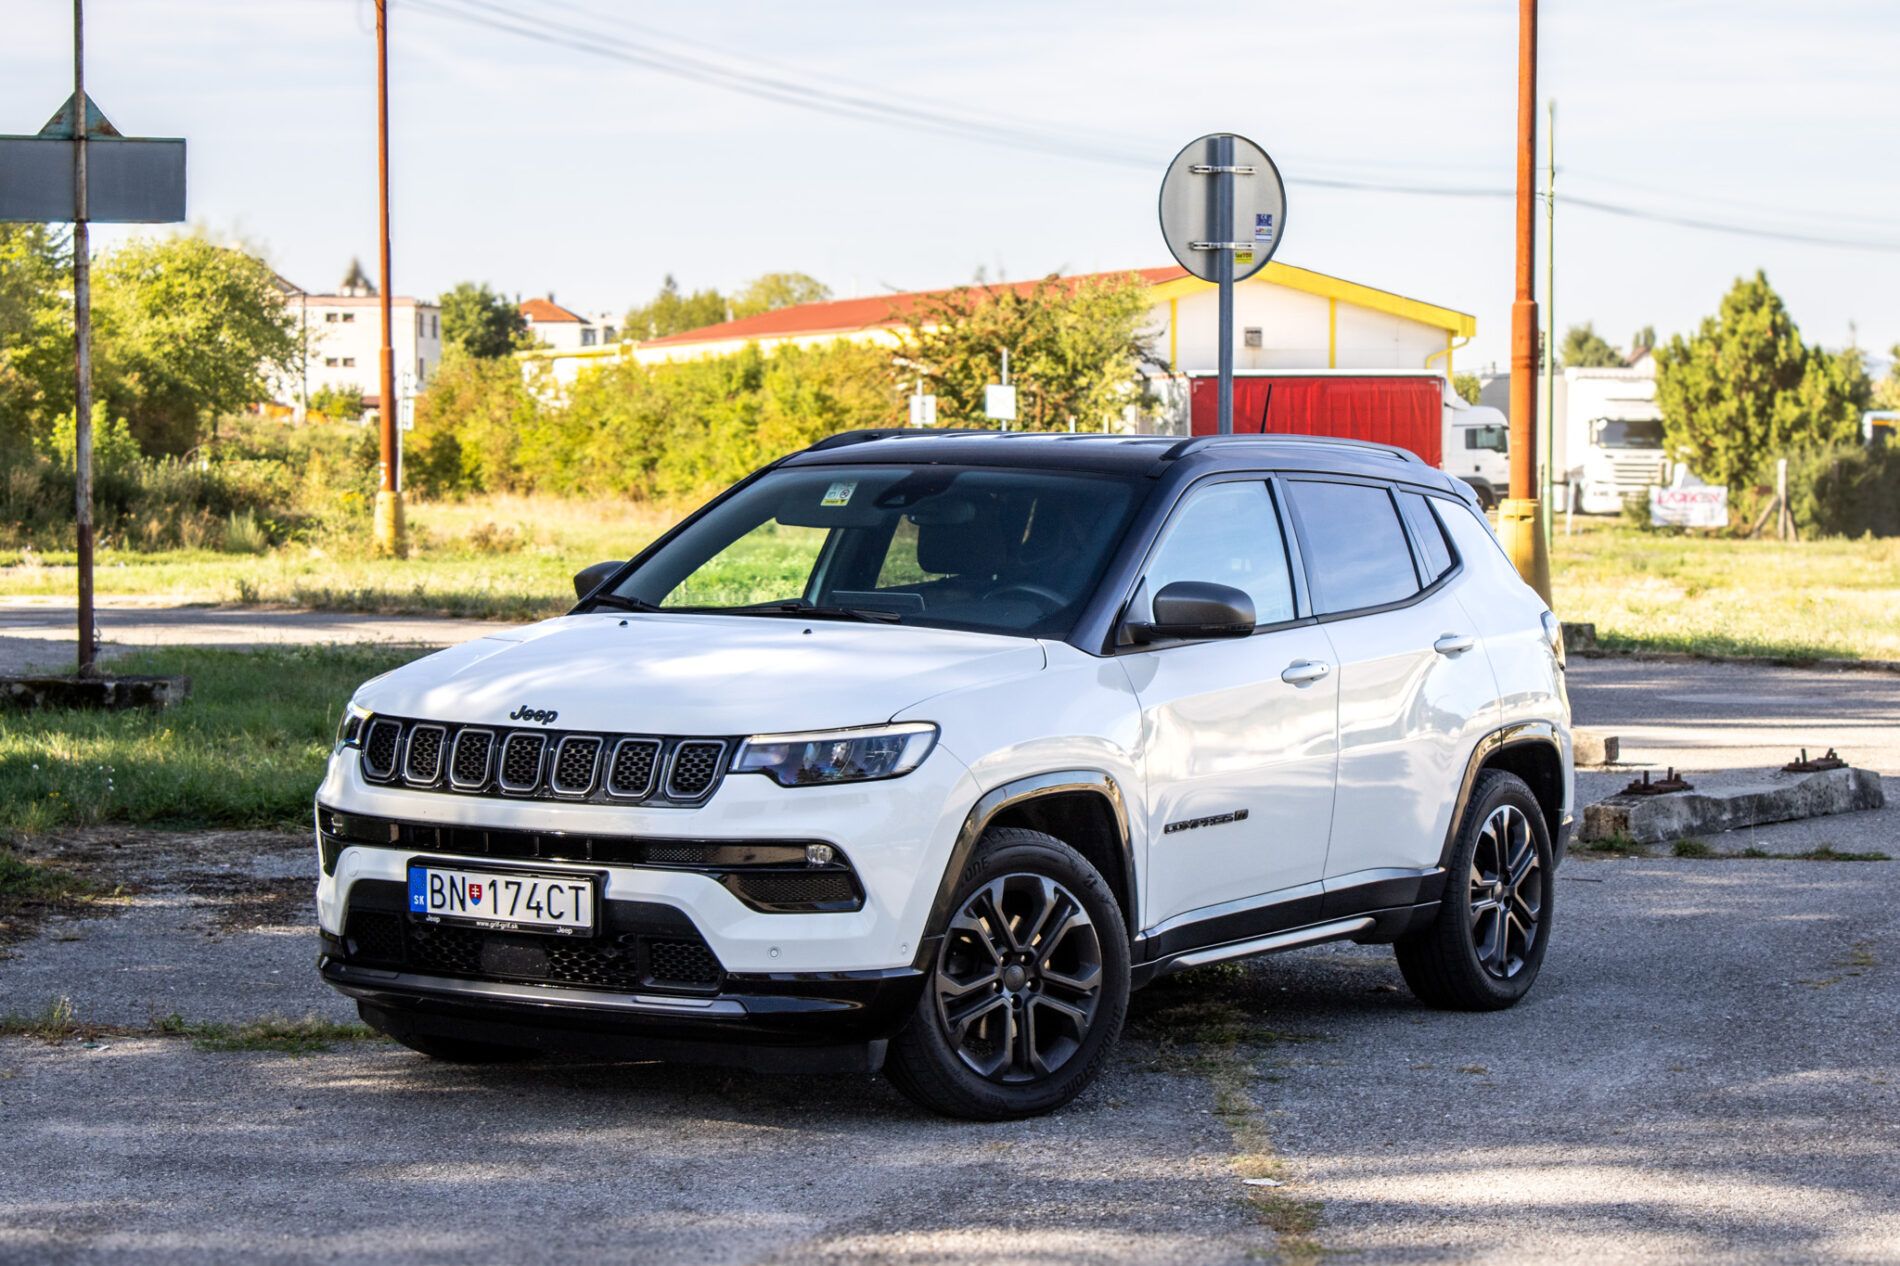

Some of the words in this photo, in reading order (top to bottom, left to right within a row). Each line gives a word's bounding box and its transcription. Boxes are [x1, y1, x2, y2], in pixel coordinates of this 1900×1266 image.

[510, 705, 558, 725] Jeep
[413, 895, 425, 905] SK
[430, 873, 466, 912] BN
[488, 879, 586, 922] 174CT
[426, 914, 440, 923] Jeep
[556, 927, 573, 935] Jeep
